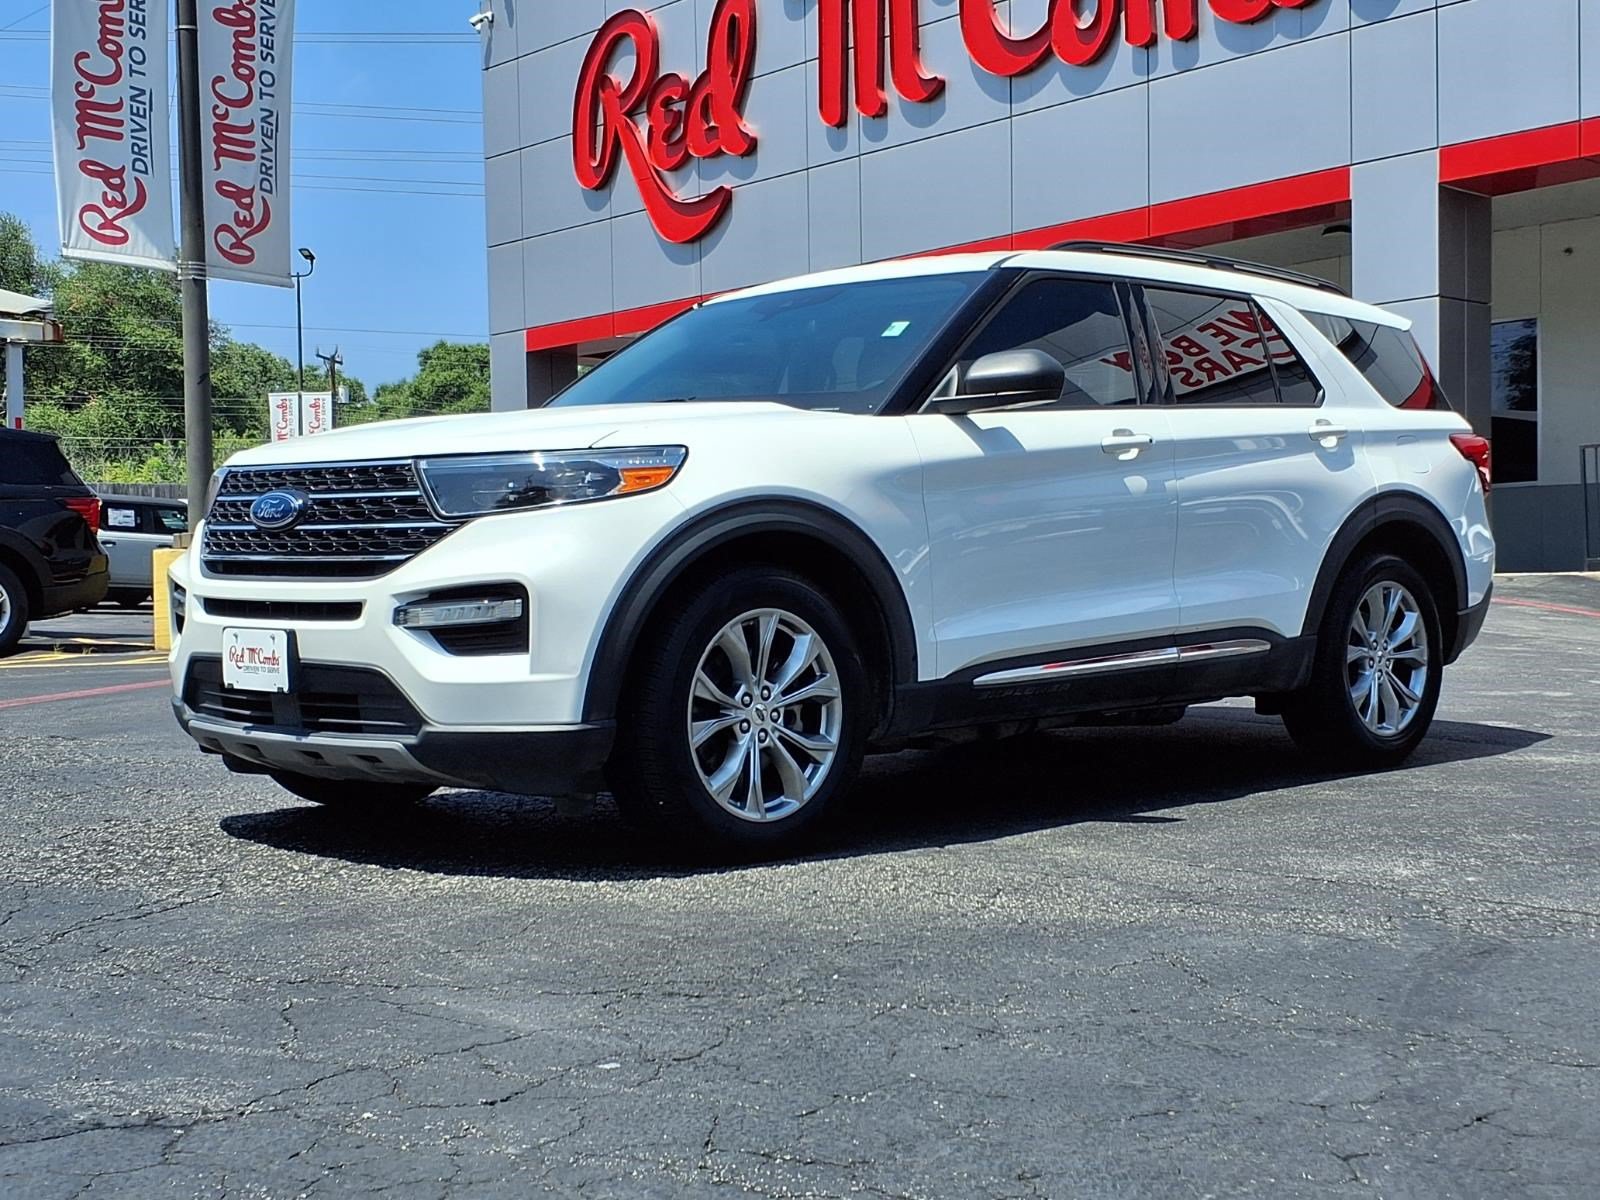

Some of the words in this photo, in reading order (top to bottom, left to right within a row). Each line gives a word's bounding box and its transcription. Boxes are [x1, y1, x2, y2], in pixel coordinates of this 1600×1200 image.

[128, 0, 147, 40] SER
[128, 45, 147, 78] TO
[73, 0, 126, 150] McCom
[259, 70, 276, 99] TO
[128, 86, 149, 176] DRIVEN
[259, 107, 275, 195] DRIVEN
[572, 0, 758, 243] Red
[78, 159, 147, 246] Red
[213, 179, 271, 265] Red
[256, 498, 285, 518] Ford
[229, 645, 245, 670] Red
